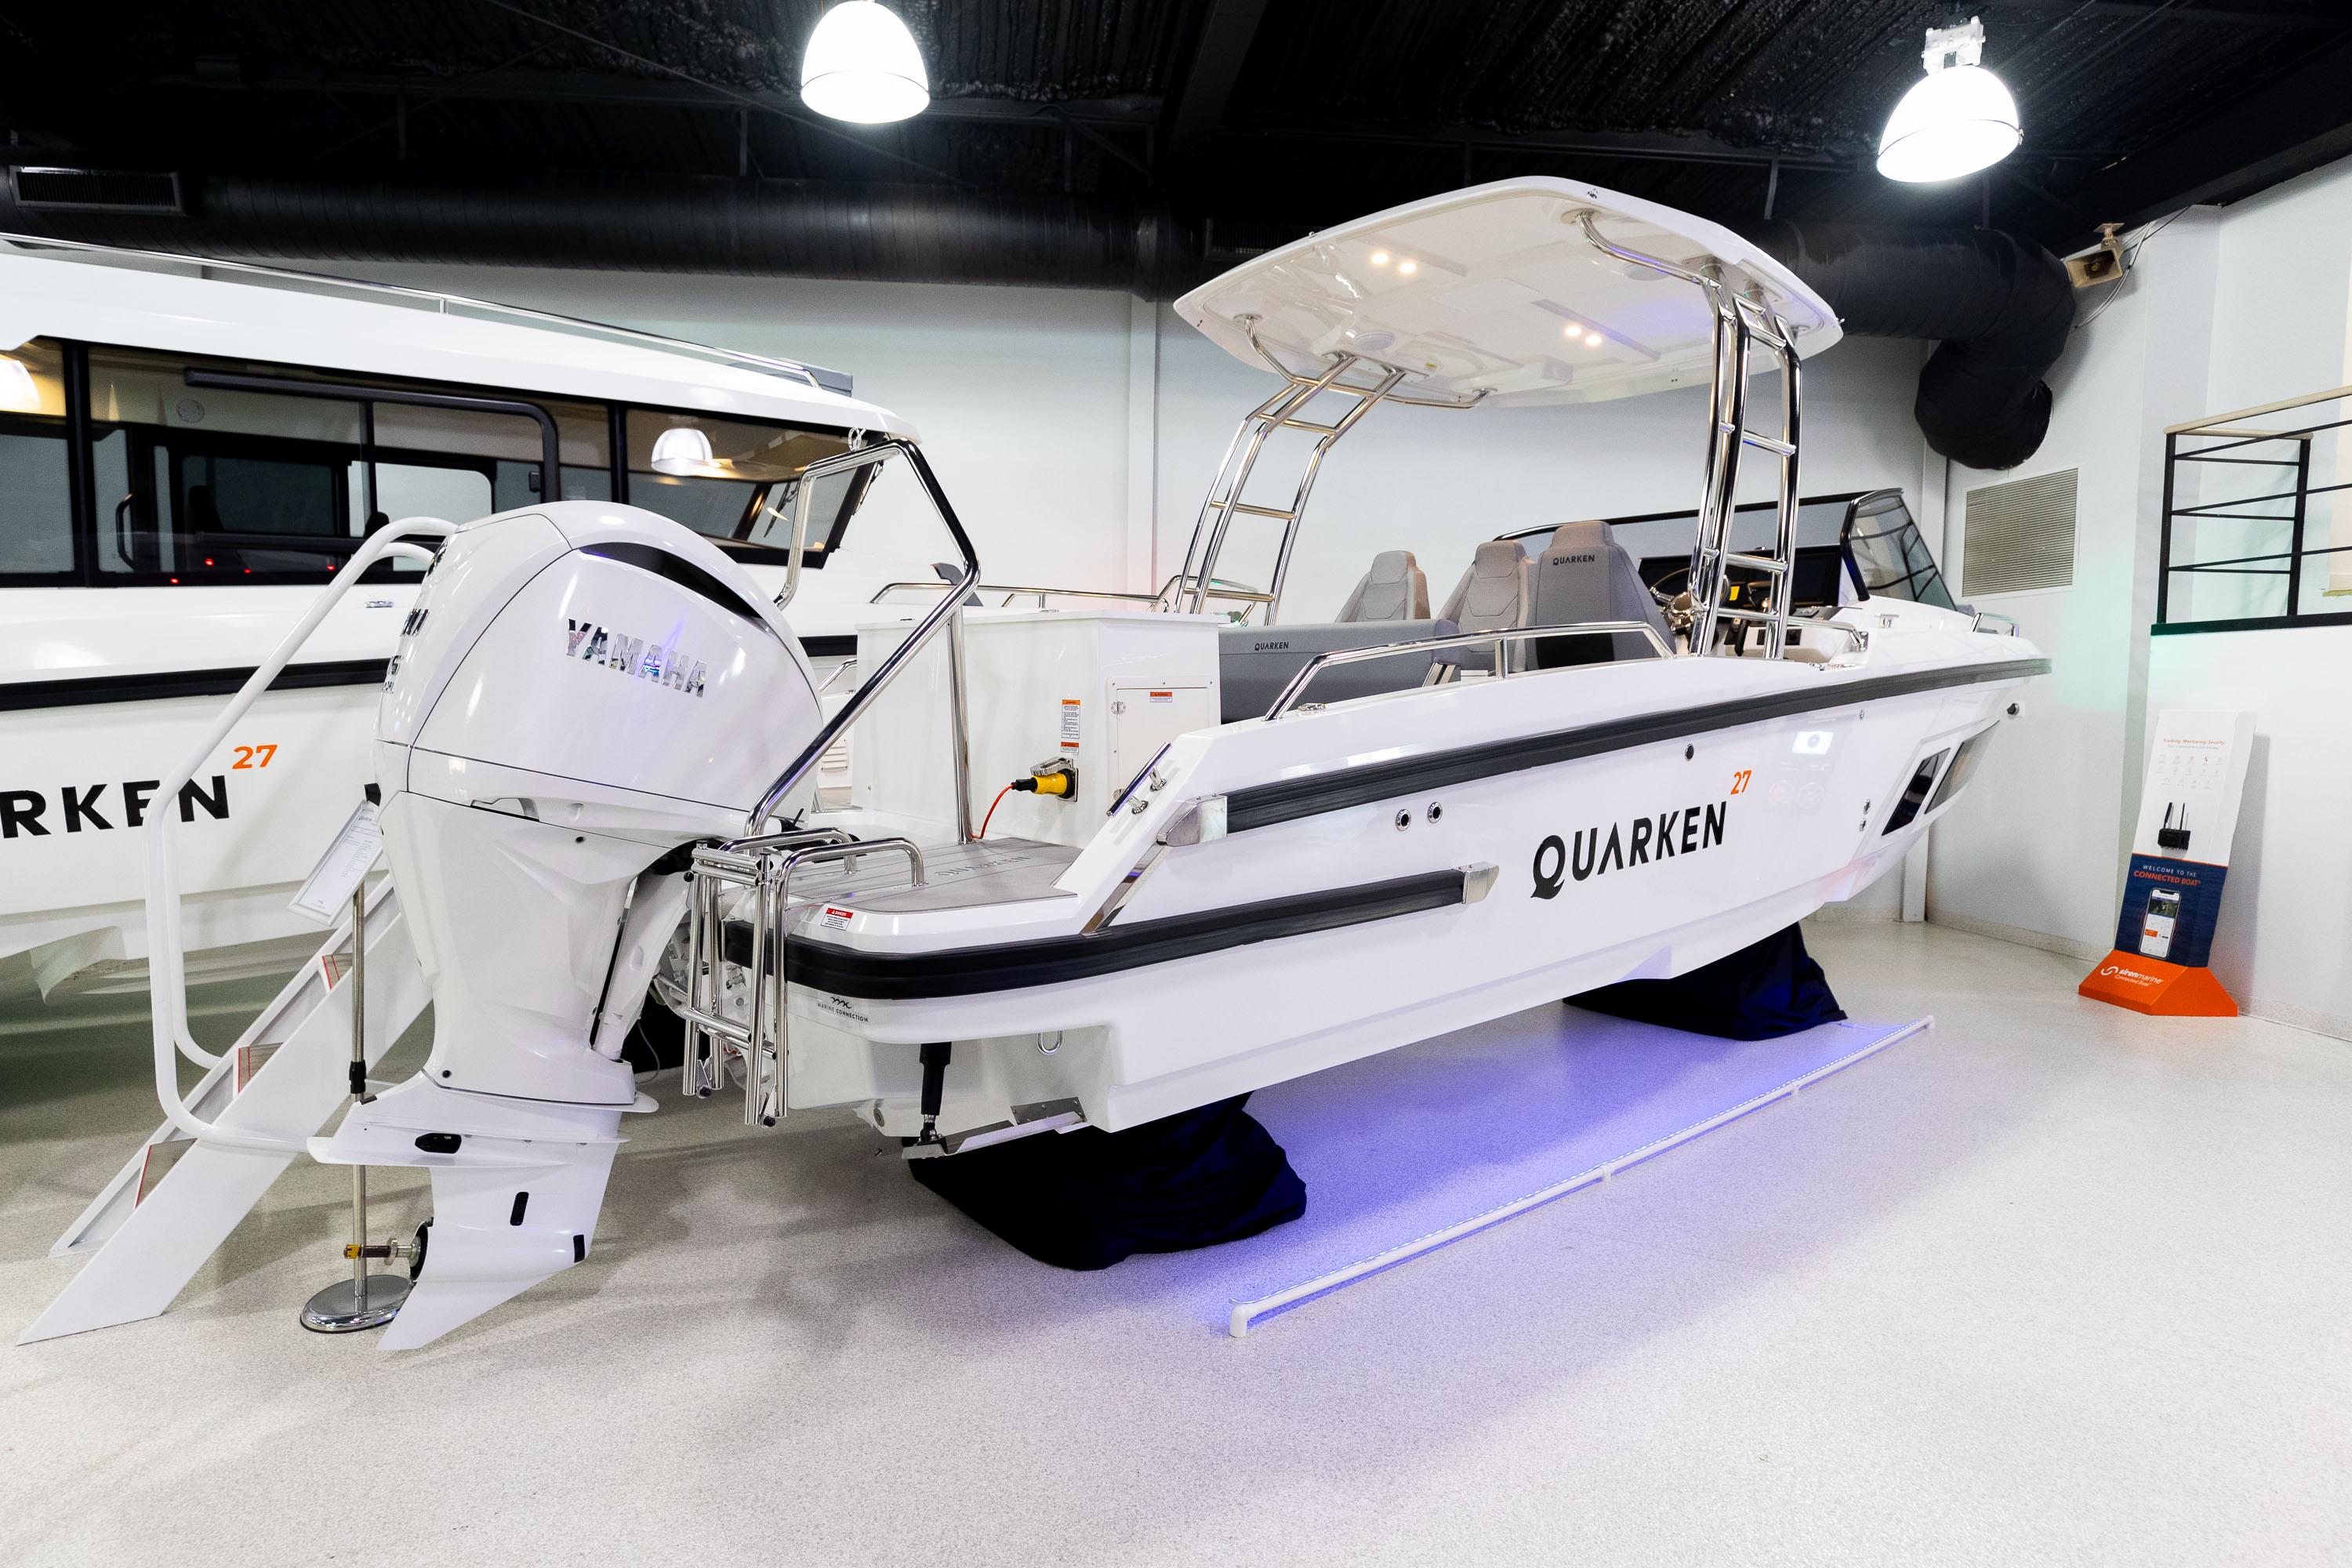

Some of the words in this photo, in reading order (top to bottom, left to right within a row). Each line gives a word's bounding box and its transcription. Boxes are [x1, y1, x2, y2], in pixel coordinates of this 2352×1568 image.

[1553, 554, 1595, 565] QUARKEN
[1254, 641, 1289, 651] QUARKEN
[566, 619, 707, 698] YAMAHA
[232, 744, 278, 769] 27
[1730, 769, 1752, 795] 27
[1530, 800, 1727, 900] QUARKEN
[2143, 865, 2174, 874] WELCOME
[2133, 870, 2180, 884] CONNECTED
[836, 1008, 869, 1022] CONNECTION
